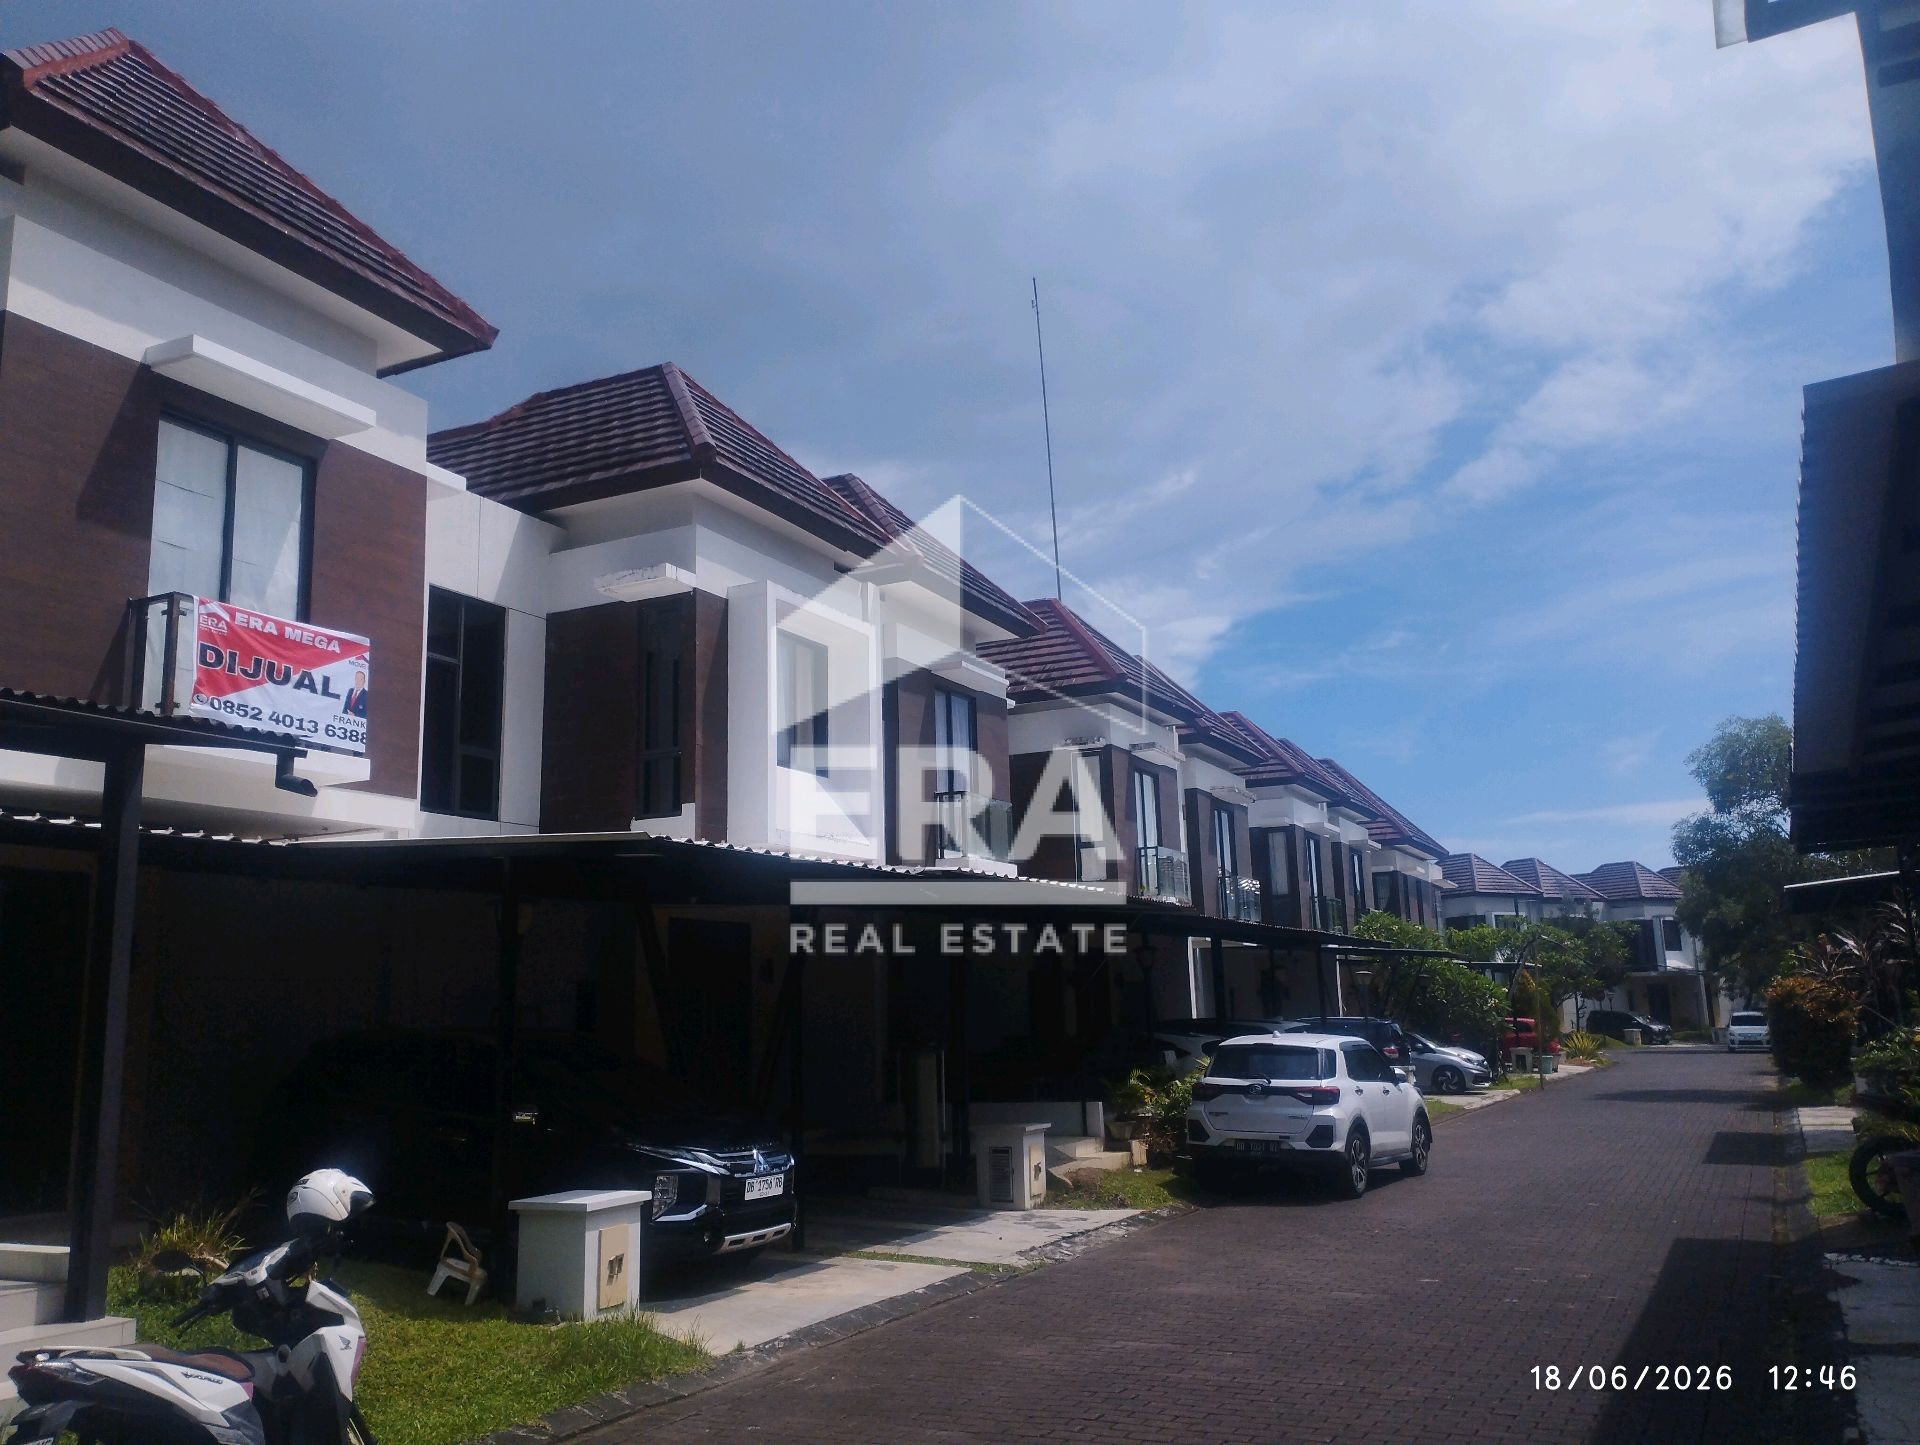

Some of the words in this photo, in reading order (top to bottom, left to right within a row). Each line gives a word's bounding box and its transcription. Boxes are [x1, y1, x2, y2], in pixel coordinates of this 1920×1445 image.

[199, 615, 228, 631] ERA
[235, 612, 278, 635] ERA
[285, 627, 340, 653] MEGA
[198, 641, 341, 700] DIJUAL
[209, 696, 263, 721] 0852
[267, 711, 319, 734] 4013
[324, 724, 367, 745] 6388
[333, 714, 366, 729] FRANK
